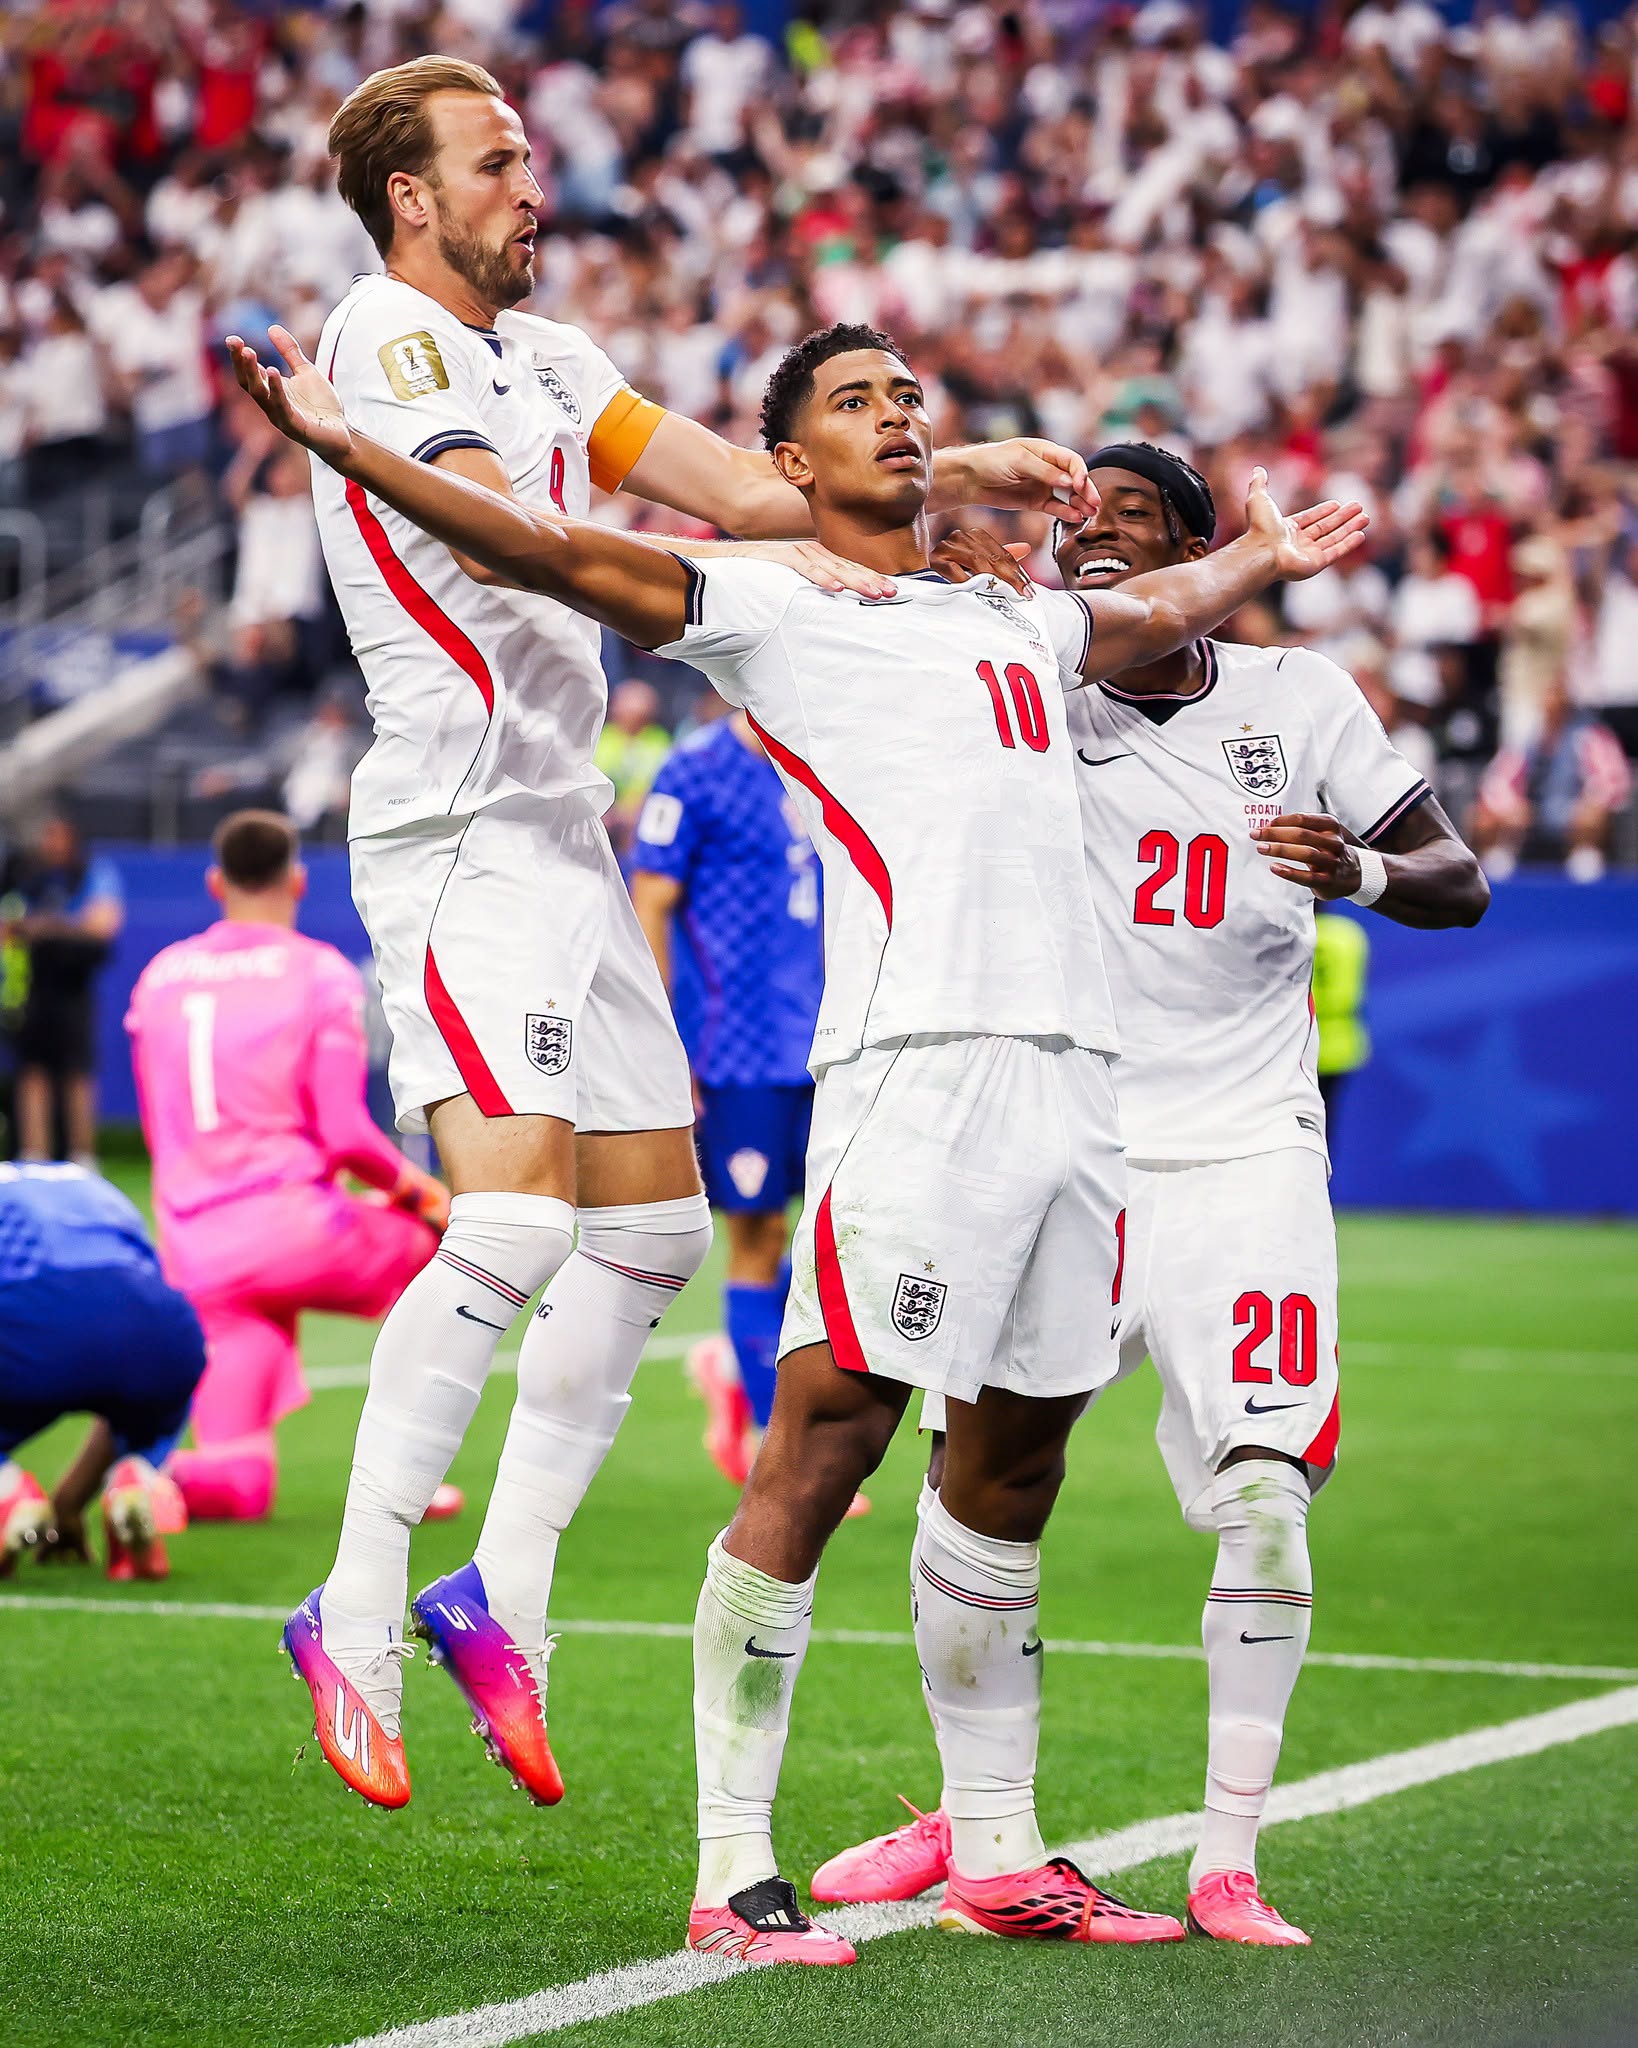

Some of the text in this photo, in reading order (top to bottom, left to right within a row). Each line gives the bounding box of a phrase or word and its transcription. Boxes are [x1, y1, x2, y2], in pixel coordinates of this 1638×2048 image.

[549, 446, 569, 516] 9
[976, 659, 1051, 753] 10
[1244, 804, 1283, 816] CROATIA
[1133, 829, 1229, 929] 20
[181, 991, 219, 1132] 1
[1232, 1290, 1317, 1387] 20
